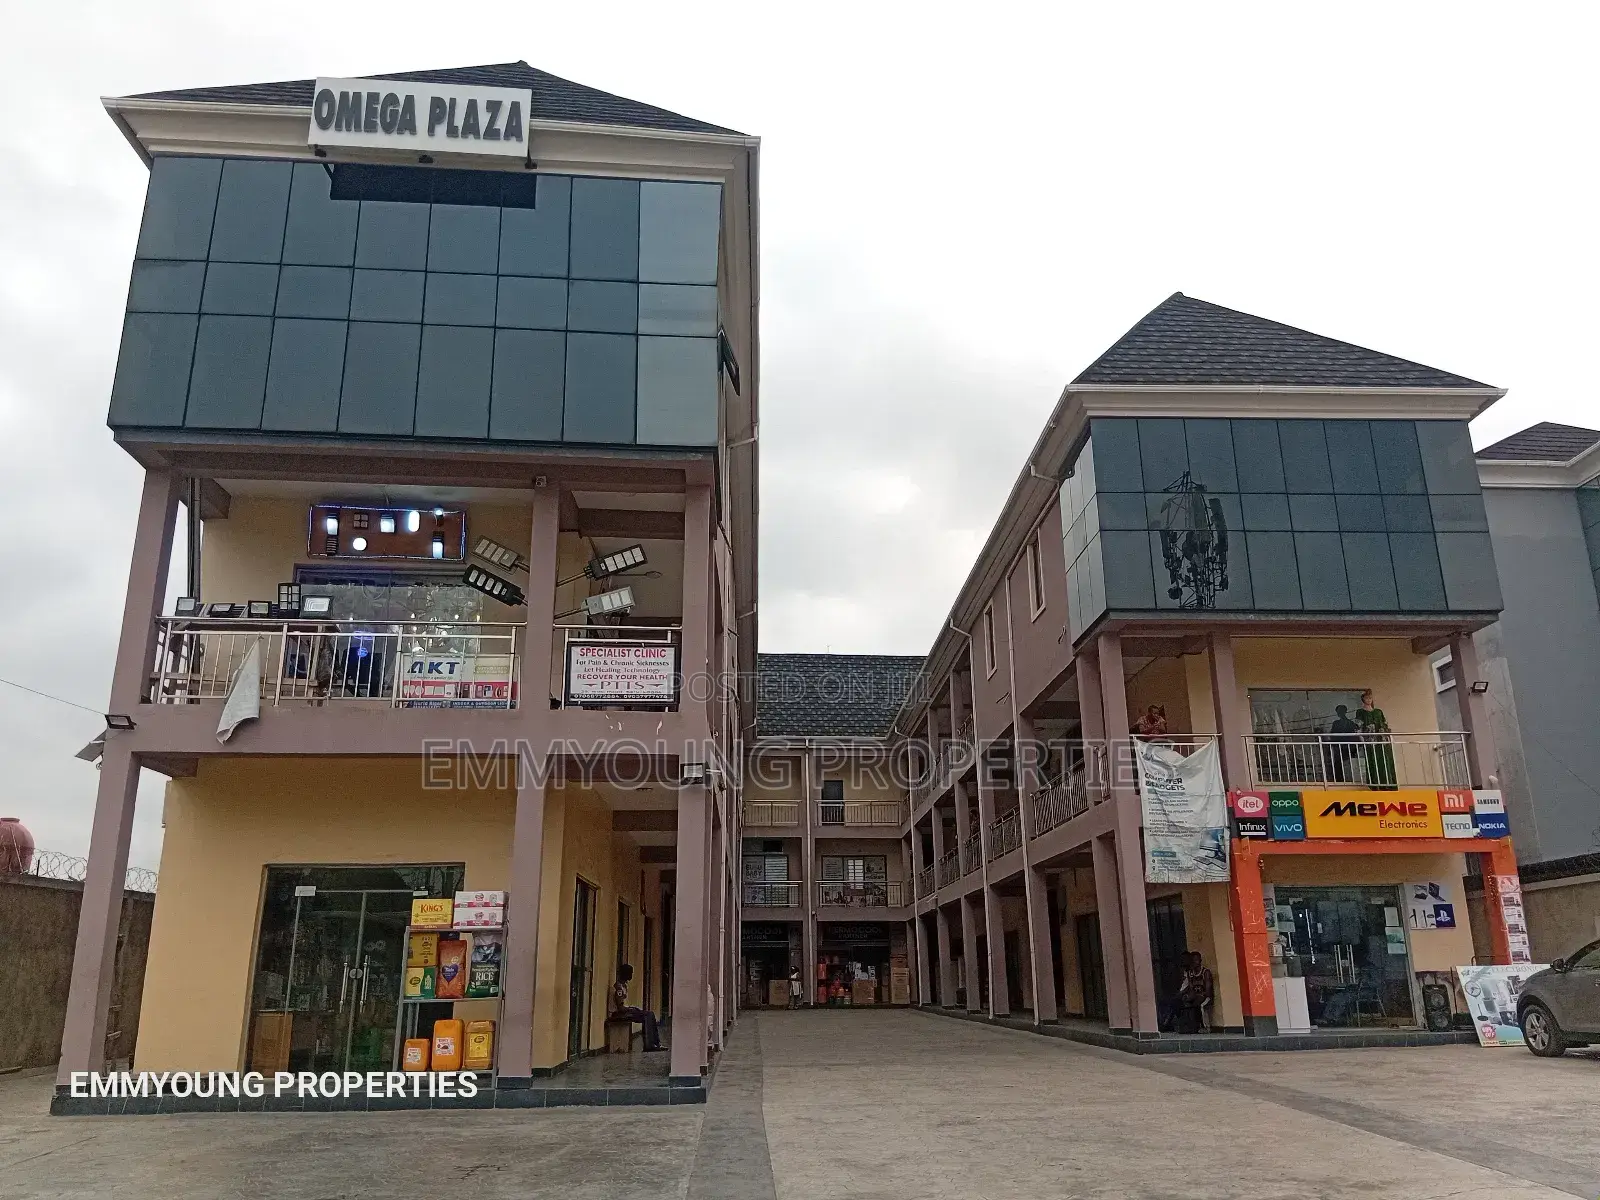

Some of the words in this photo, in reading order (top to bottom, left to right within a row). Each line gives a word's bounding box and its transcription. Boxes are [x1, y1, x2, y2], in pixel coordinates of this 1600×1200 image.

[314, 88, 417, 135] OMEGA
[427, 96, 524, 142] PLAZA
[580, 648, 631, 657] SPECIALIST
[634, 649, 667, 658] CLINIC
[407, 661, 460, 674] AKT
[1242, 799, 1259, 808] itel
[1379, 819, 1428, 829] Electronics
[1445, 822, 1471, 830] TECNO
[475, 972, 494, 981] RICE
